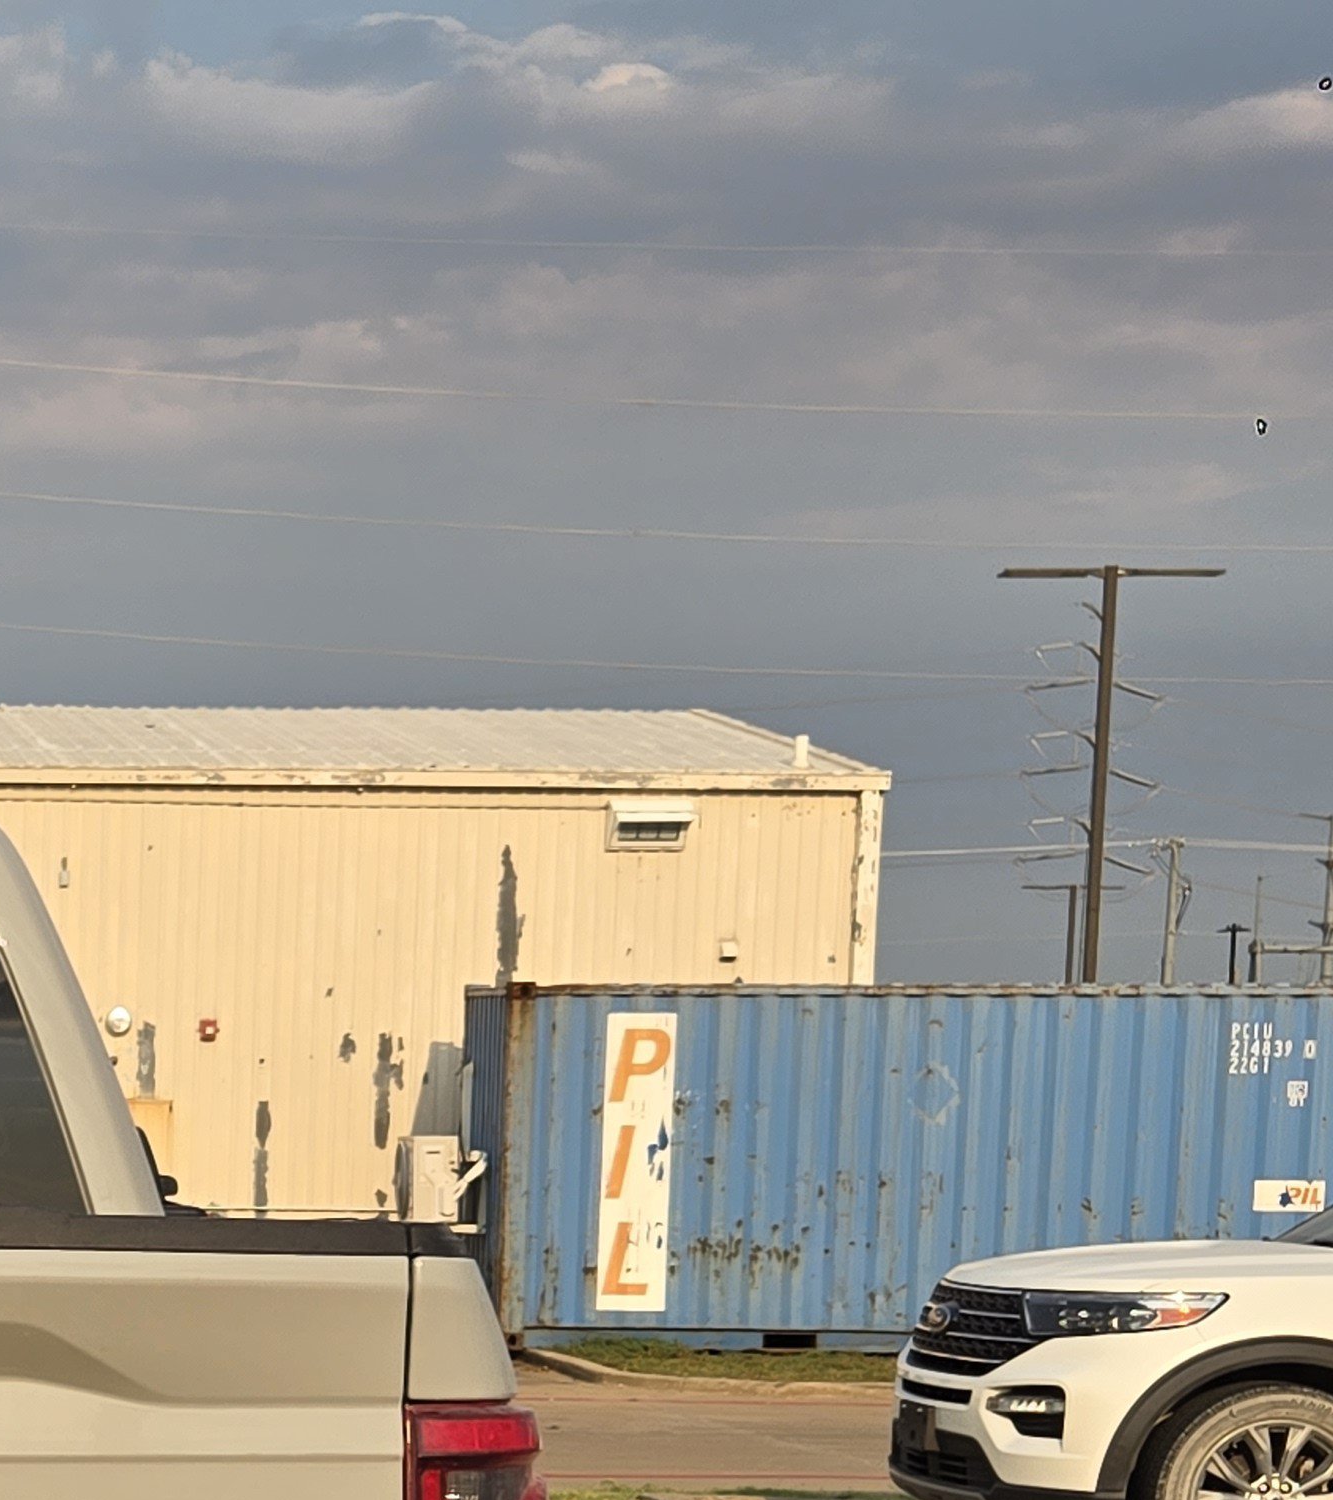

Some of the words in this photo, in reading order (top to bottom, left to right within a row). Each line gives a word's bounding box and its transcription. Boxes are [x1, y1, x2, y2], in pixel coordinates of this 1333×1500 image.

[1231, 1022, 1273, 1039] PCIU
[1230, 1039, 1293, 1058] 214839
[1228, 1057, 1269, 1074] 22G1
[601, 1028, 672, 1296] PIL
